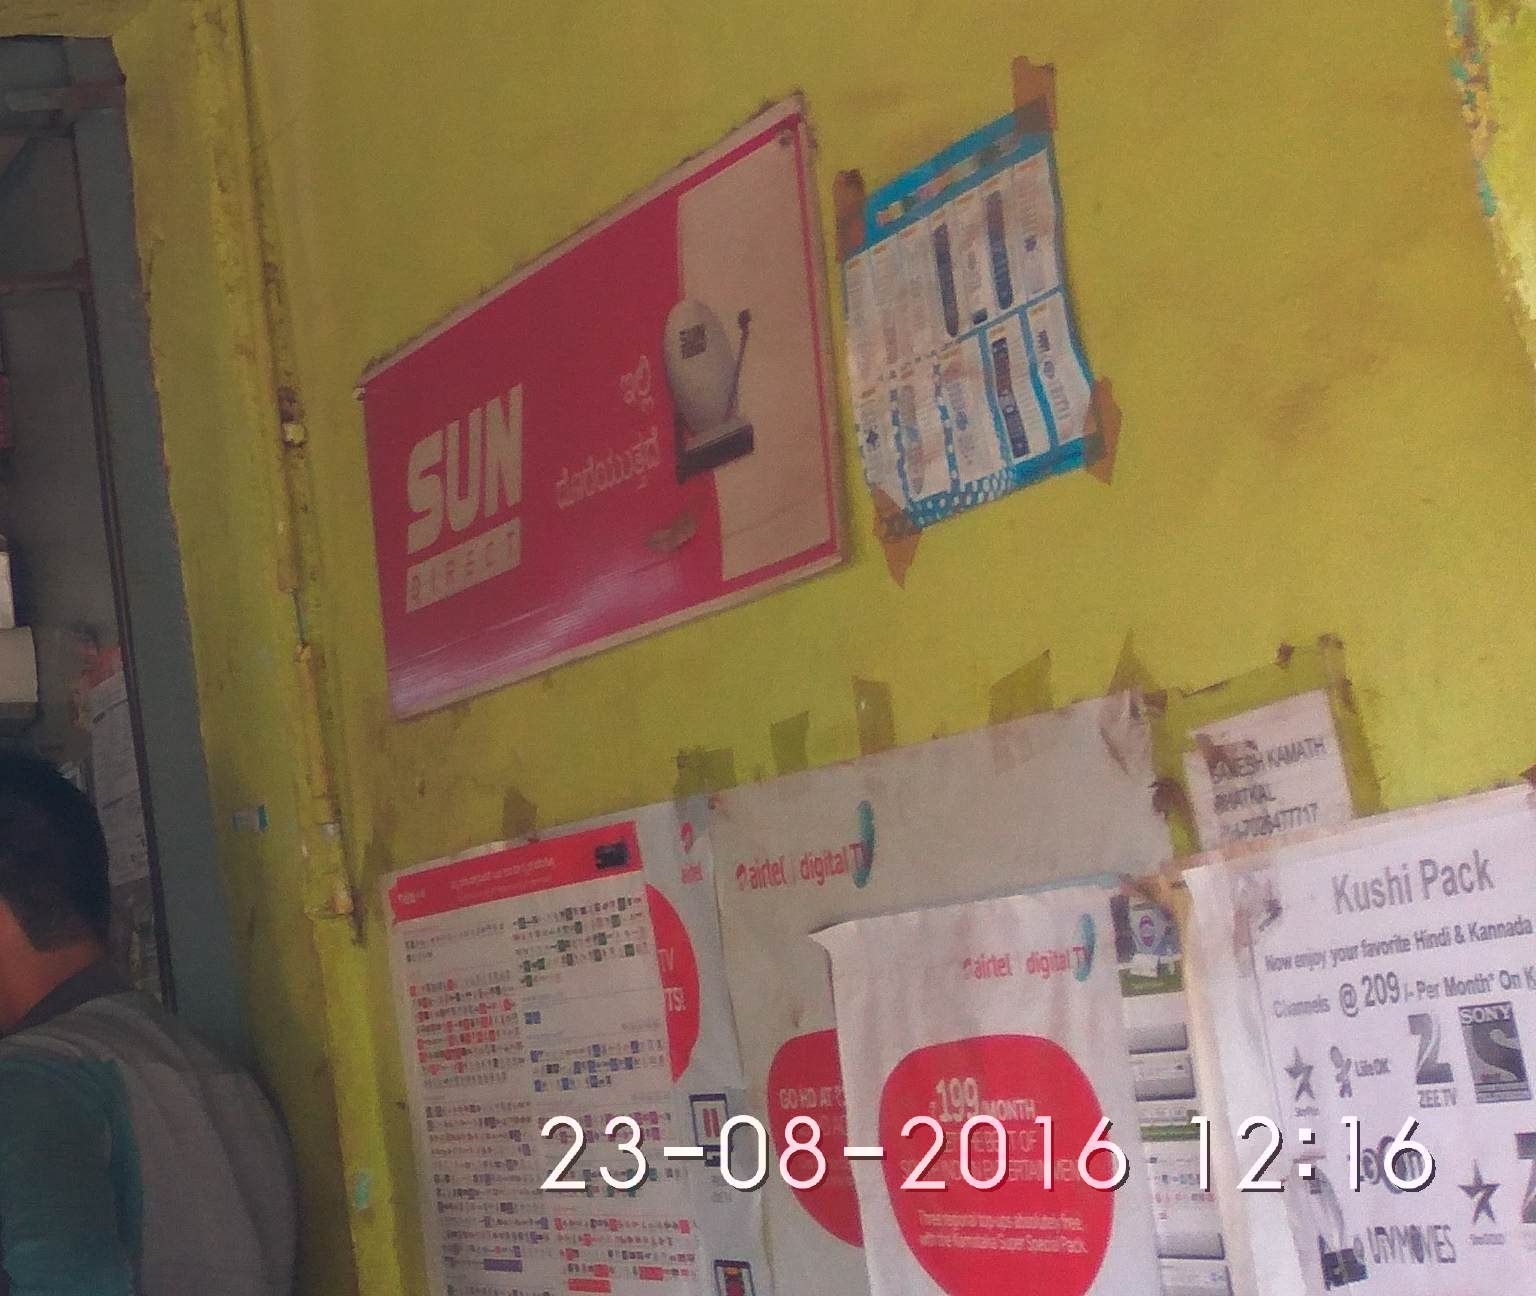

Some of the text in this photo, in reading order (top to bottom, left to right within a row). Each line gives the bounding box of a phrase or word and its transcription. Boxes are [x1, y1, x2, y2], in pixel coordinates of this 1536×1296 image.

[406, 383, 524, 555] SUN
[749, 855, 785, 890] airtel
[799, 845, 849, 886] digital
[1331, 849, 1495, 915] Kushi Pack
[973, 952, 1012, 981] airtel
[1025, 948, 1071, 979] digital
[1294, 948, 1327, 971] enjoy
[1330, 944, 1359, 968] your
[1360, 934, 1412, 958] favorite
[1413, 926, 1452, 951] Hindi
[1453, 924, 1466, 945] &
[1467, 914, 1534, 943] Kannada
[1498, 969, 1521, 991] On
[1460, 1006, 1513, 1025] SONY
